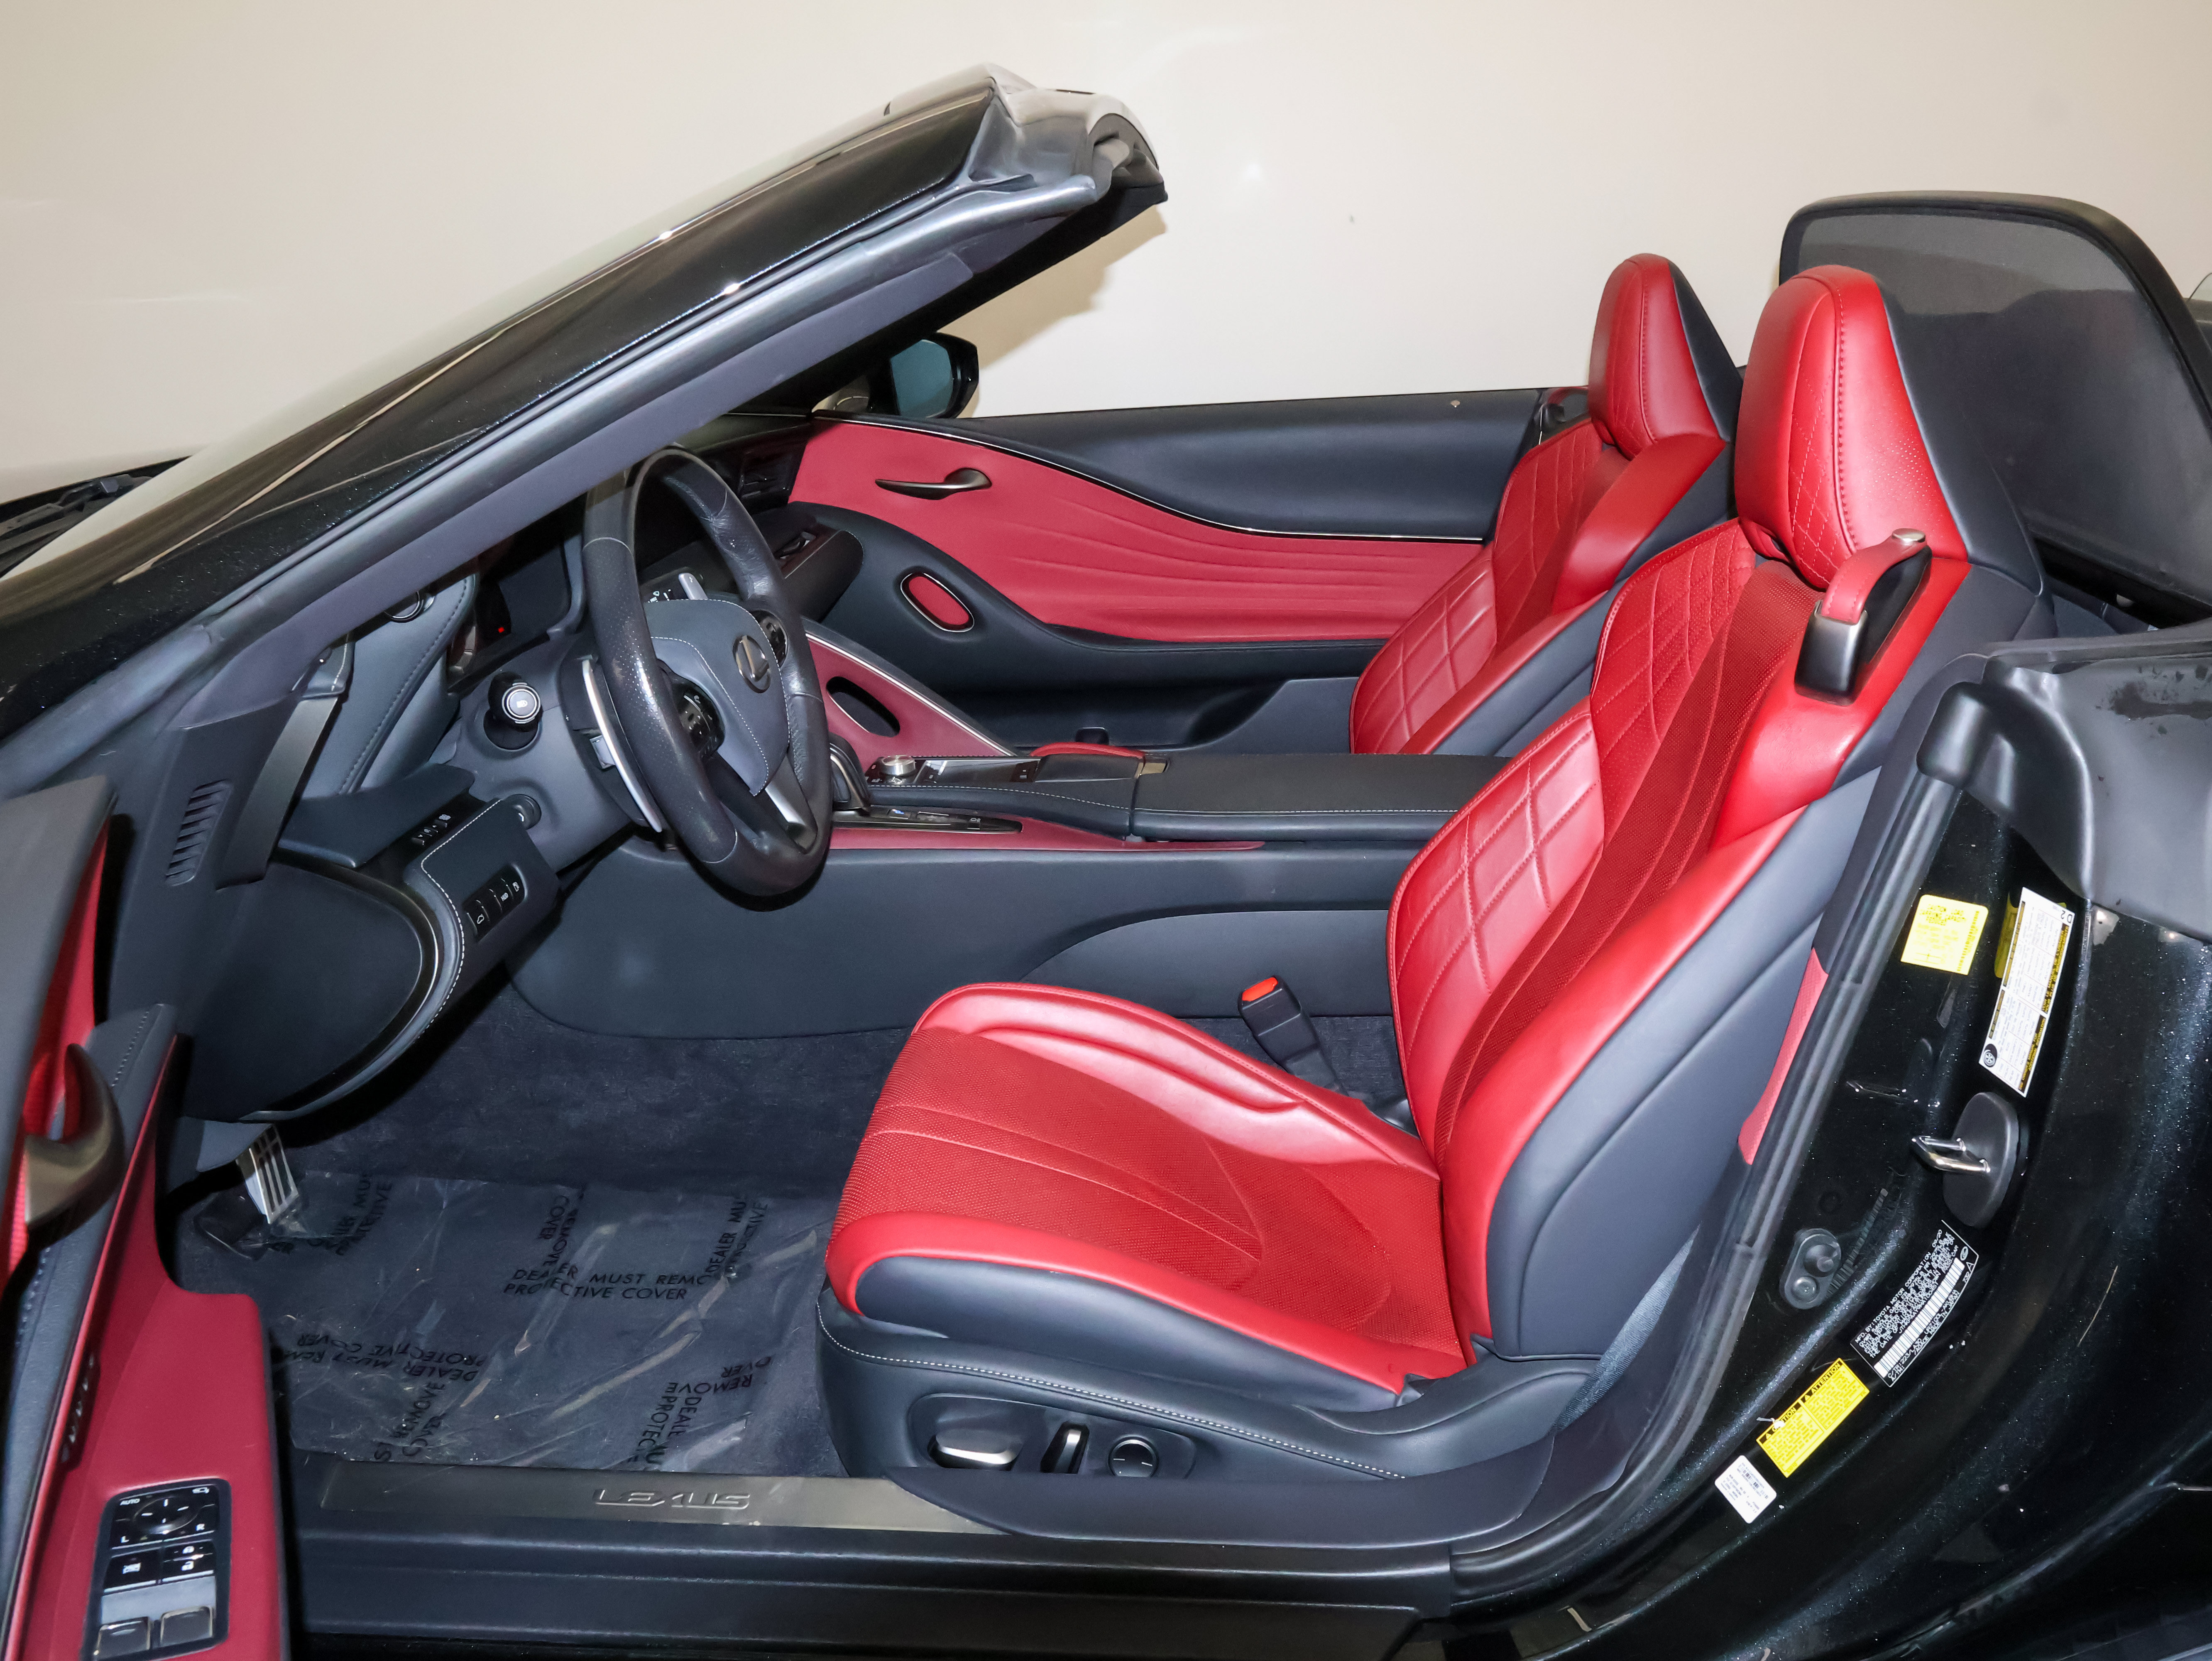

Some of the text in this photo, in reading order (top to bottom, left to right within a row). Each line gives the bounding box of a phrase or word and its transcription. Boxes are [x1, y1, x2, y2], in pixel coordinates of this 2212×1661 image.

[705, 1232, 738, 1273] DEALER
[512, 1263, 578, 1280] DEALER
[590, 1274, 646, 1285] MUST
[1889, 1287, 1905, 1305] MOTOR
[1904, 1252, 1931, 1287] CORPORATION
[1931, 1229, 1942, 1247] 09/20
[503, 1276, 688, 1300] PROTECTIVE COVER
[1885, 1314, 1900, 1330] MOTOR
[1929, 1320, 1941, 1335] MADE
[1941, 1310, 1948, 1318] IN
[1947, 1291, 1960, 1309] JAPAN
[297, 1334, 363, 1353] COVER
[1870, 1348, 1880, 1358] THE
[1879, 1334, 1892, 1348] DATE
[1892, 1325, 1899, 1334] OF
[403, 1360, 480, 1382] DEALER
[1810, 1362, 1841, 1394] ATTENTION
[665, 1373, 753, 1394] REMOVE
[593, 1490, 750, 1510] LEXUS
